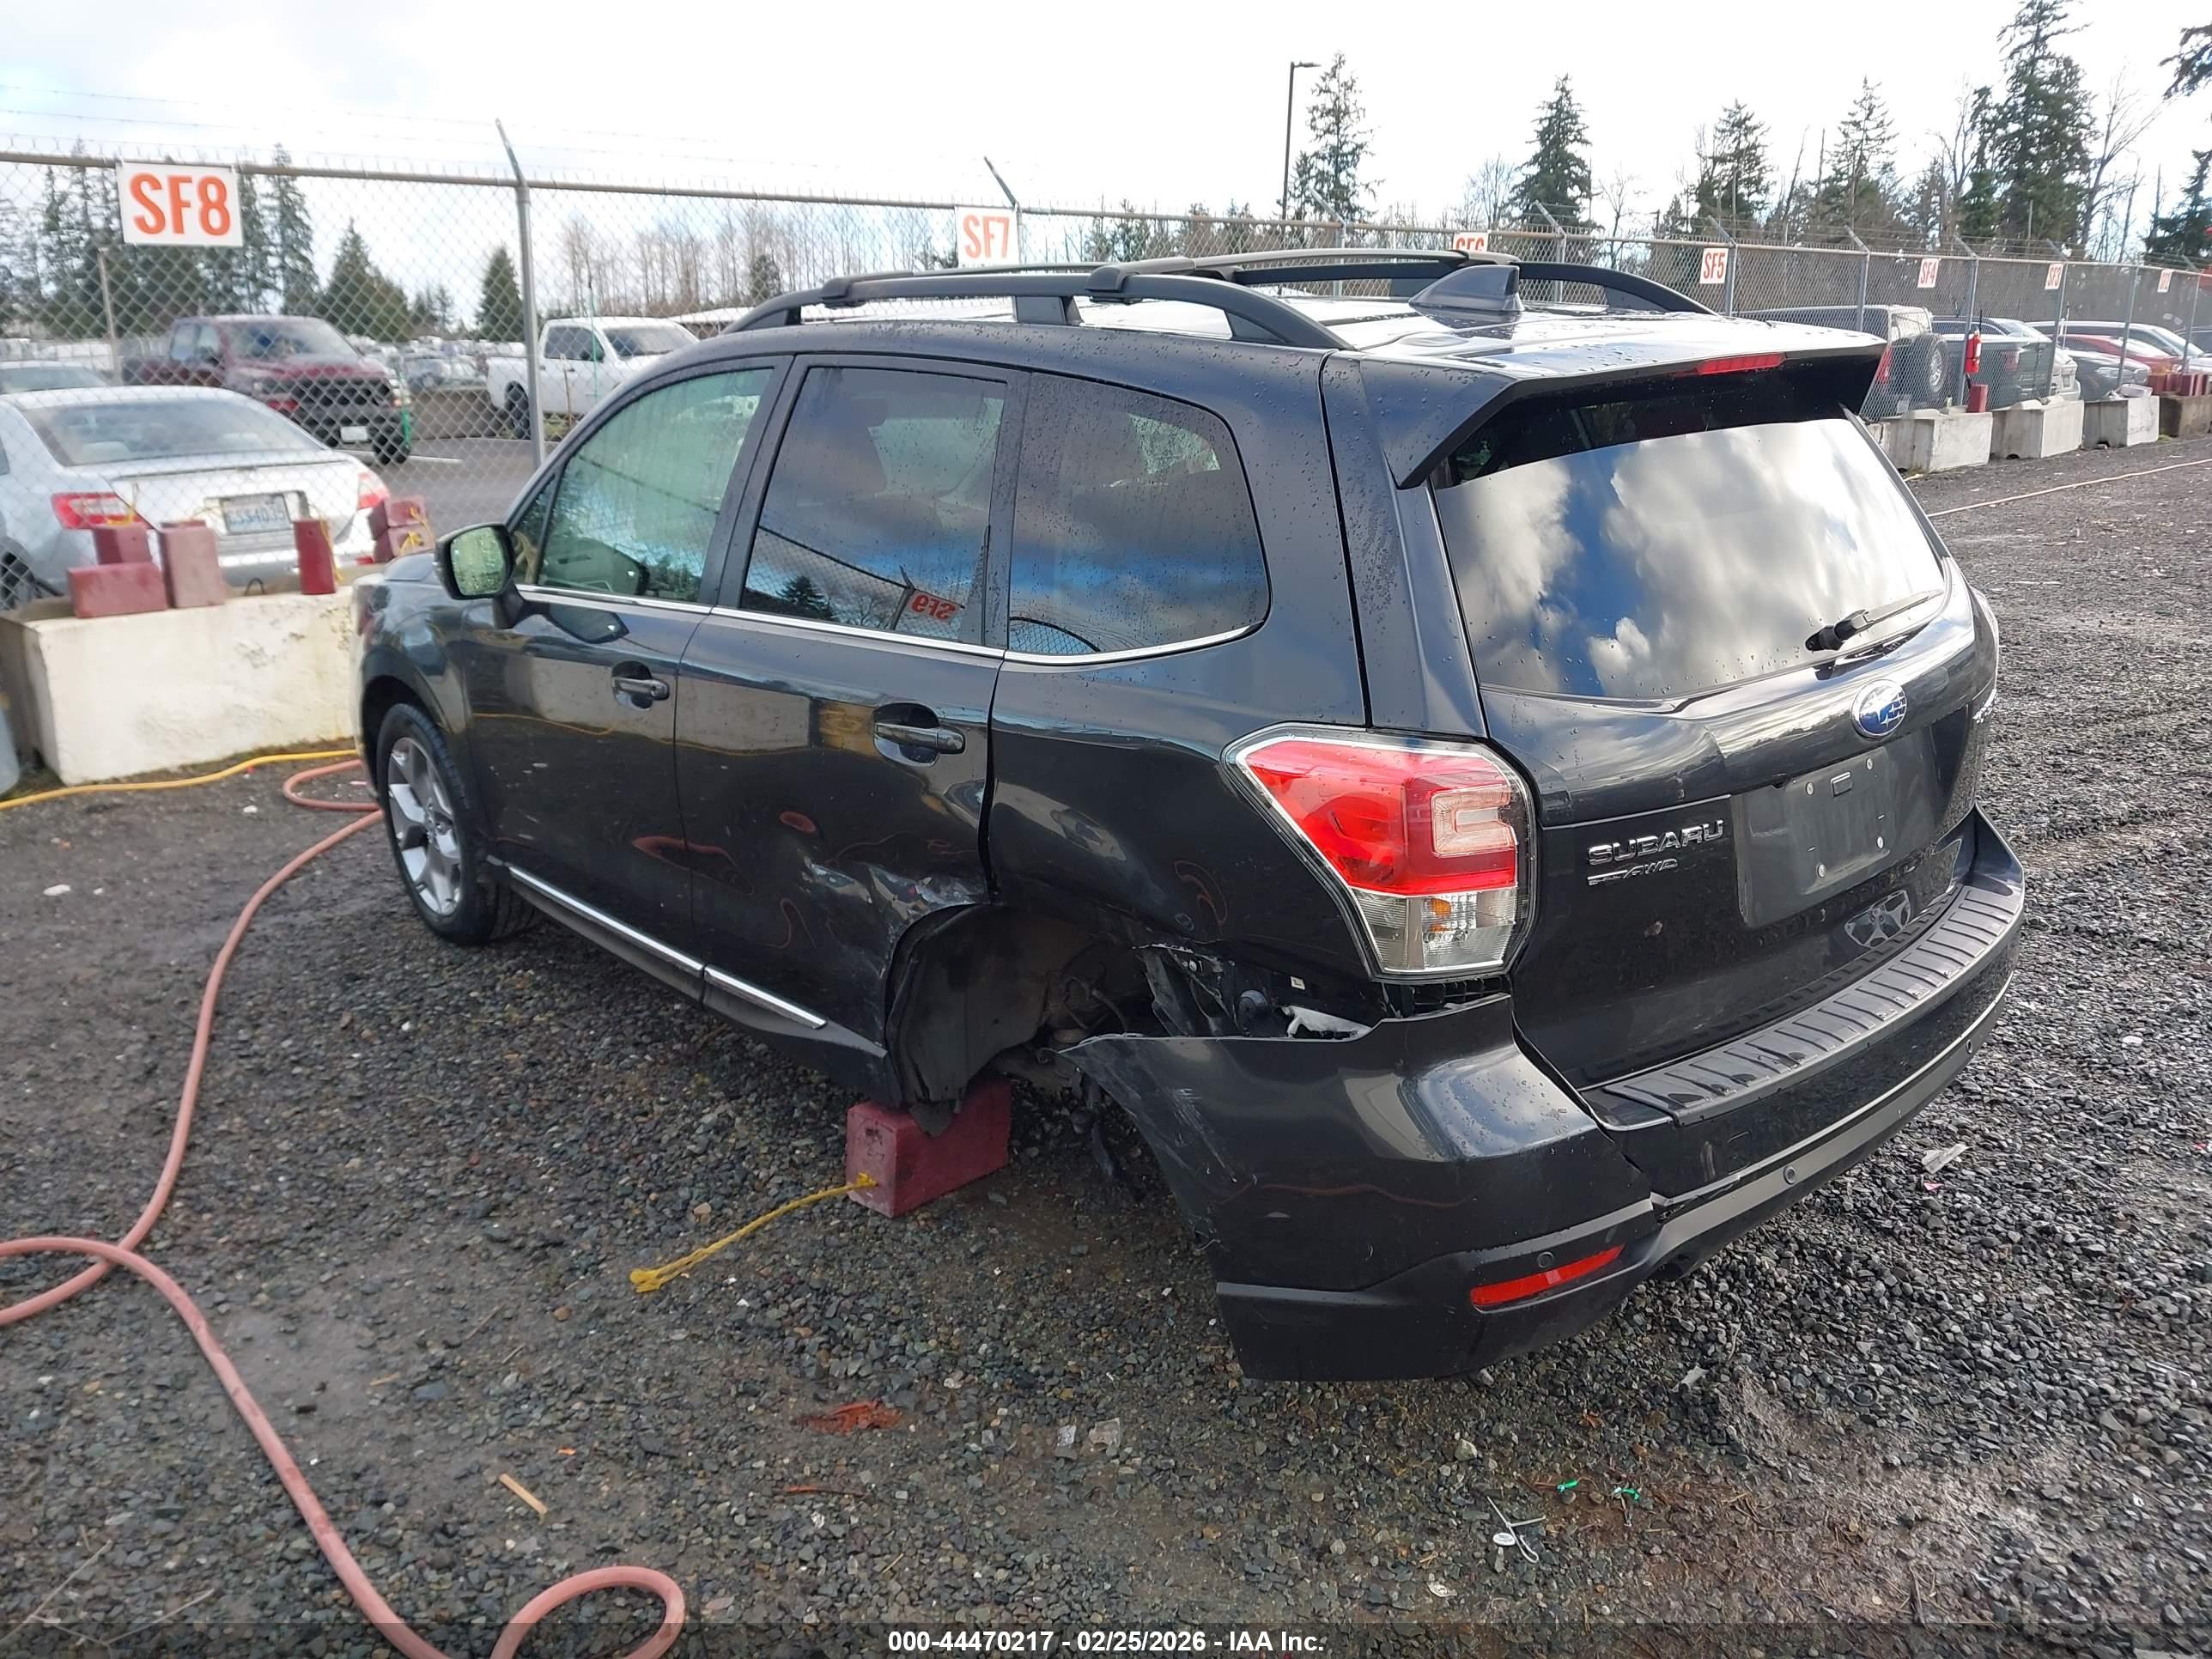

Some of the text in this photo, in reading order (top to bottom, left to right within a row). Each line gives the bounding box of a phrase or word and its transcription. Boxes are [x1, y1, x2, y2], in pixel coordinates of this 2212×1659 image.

[131, 173, 231, 236] SF8
[962, 216, 1010, 259] SF7
[1704, 252, 1725, 279] SF5
[1920, 261, 1937, 283] SF4
[1589, 819, 1723, 866] SUBARU
